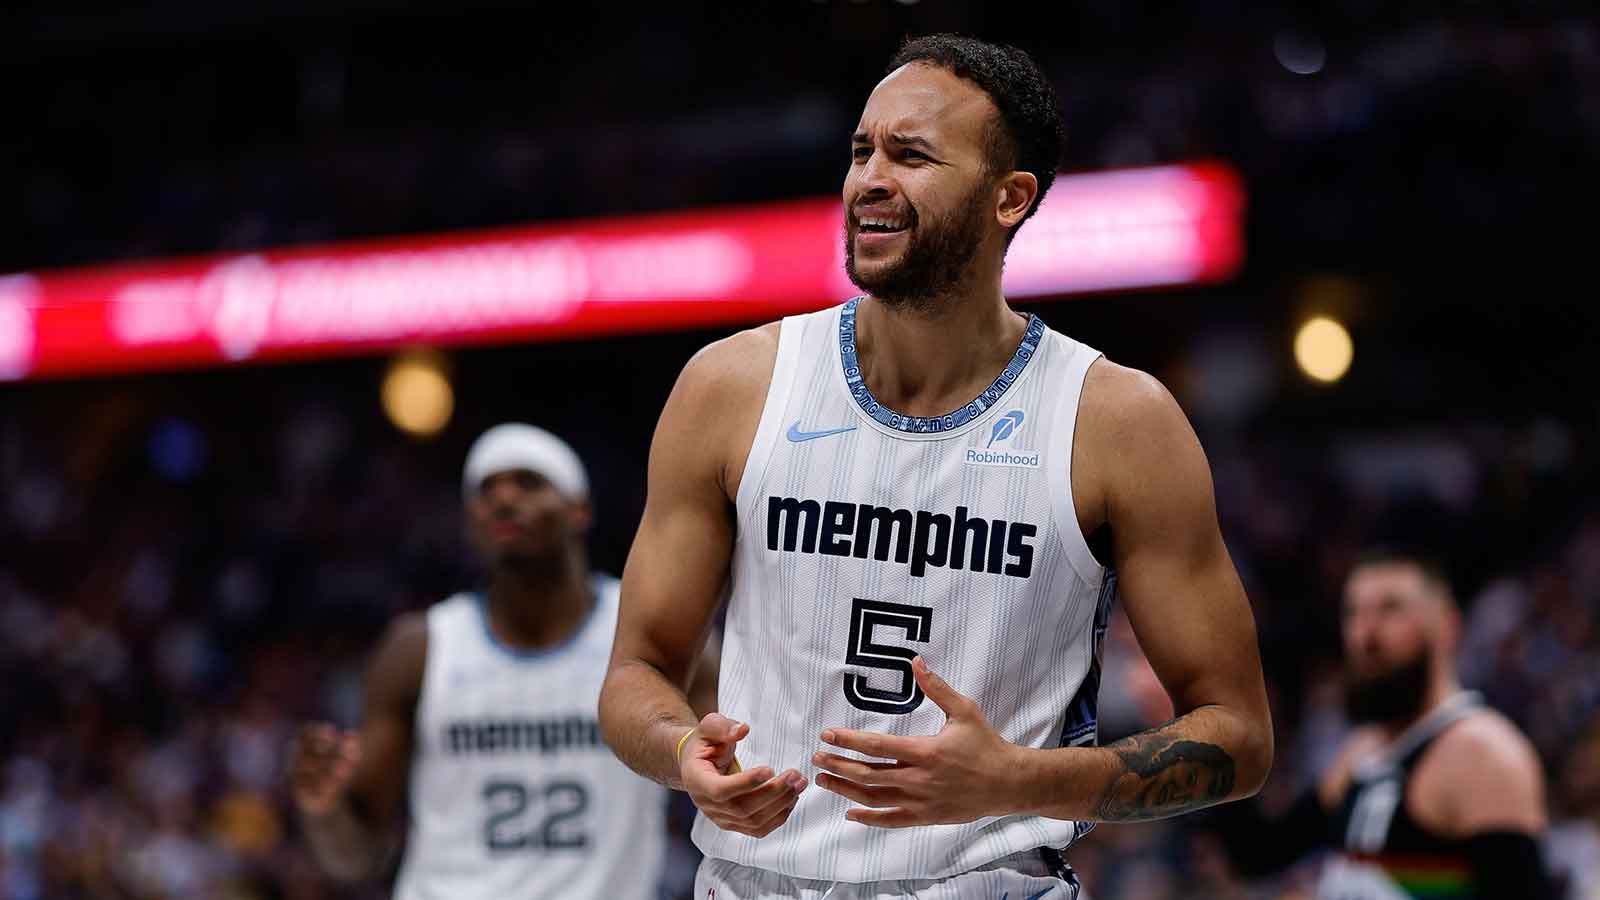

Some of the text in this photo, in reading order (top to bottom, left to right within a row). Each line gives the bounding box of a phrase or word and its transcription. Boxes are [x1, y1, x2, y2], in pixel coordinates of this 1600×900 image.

[966, 449, 1039, 467] Robinhood
[767, 496, 1037, 578] memphis
[843, 598, 933, 715] 5
[444, 717, 598, 755] memphi
[484, 780, 590, 851] 22
